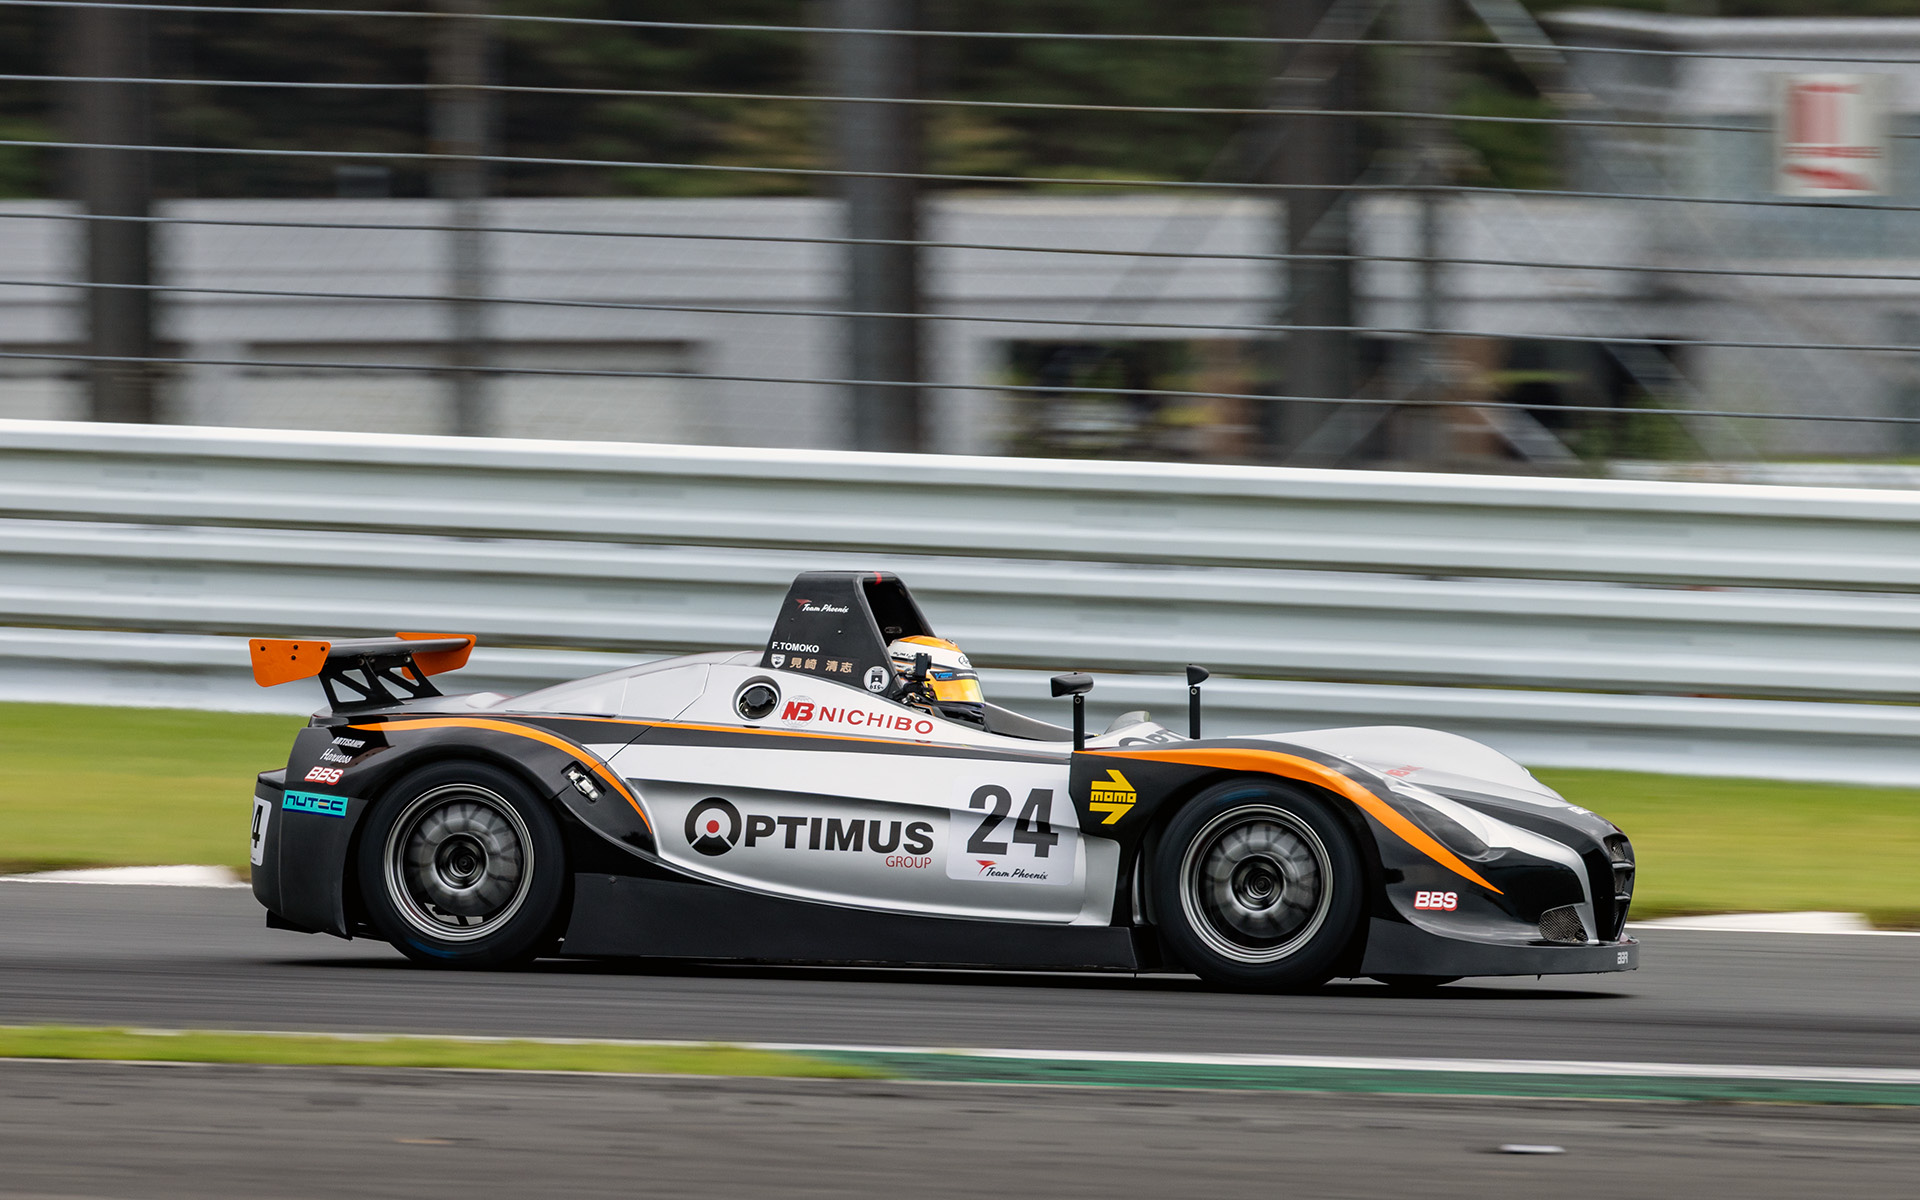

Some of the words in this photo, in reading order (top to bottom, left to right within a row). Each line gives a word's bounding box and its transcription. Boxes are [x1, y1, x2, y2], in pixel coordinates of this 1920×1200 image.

[802, 603, 820, 612] Team
[820, 603, 849, 614] Phoenix
[771, 641, 820, 653] F.TOMOKO
[819, 706, 934, 734] NICHIBO
[304, 766, 344, 785] BBS
[285, 794, 344, 812] NUTEC
[684, 796, 934, 857] OPTIMUS
[966, 784, 1060, 859] 24
[885, 855, 932, 869] GROUP
[986, 866, 1010, 877] Team
[1011, 868, 1049, 880] Phoenix
[1414, 891, 1458, 911] BBS
